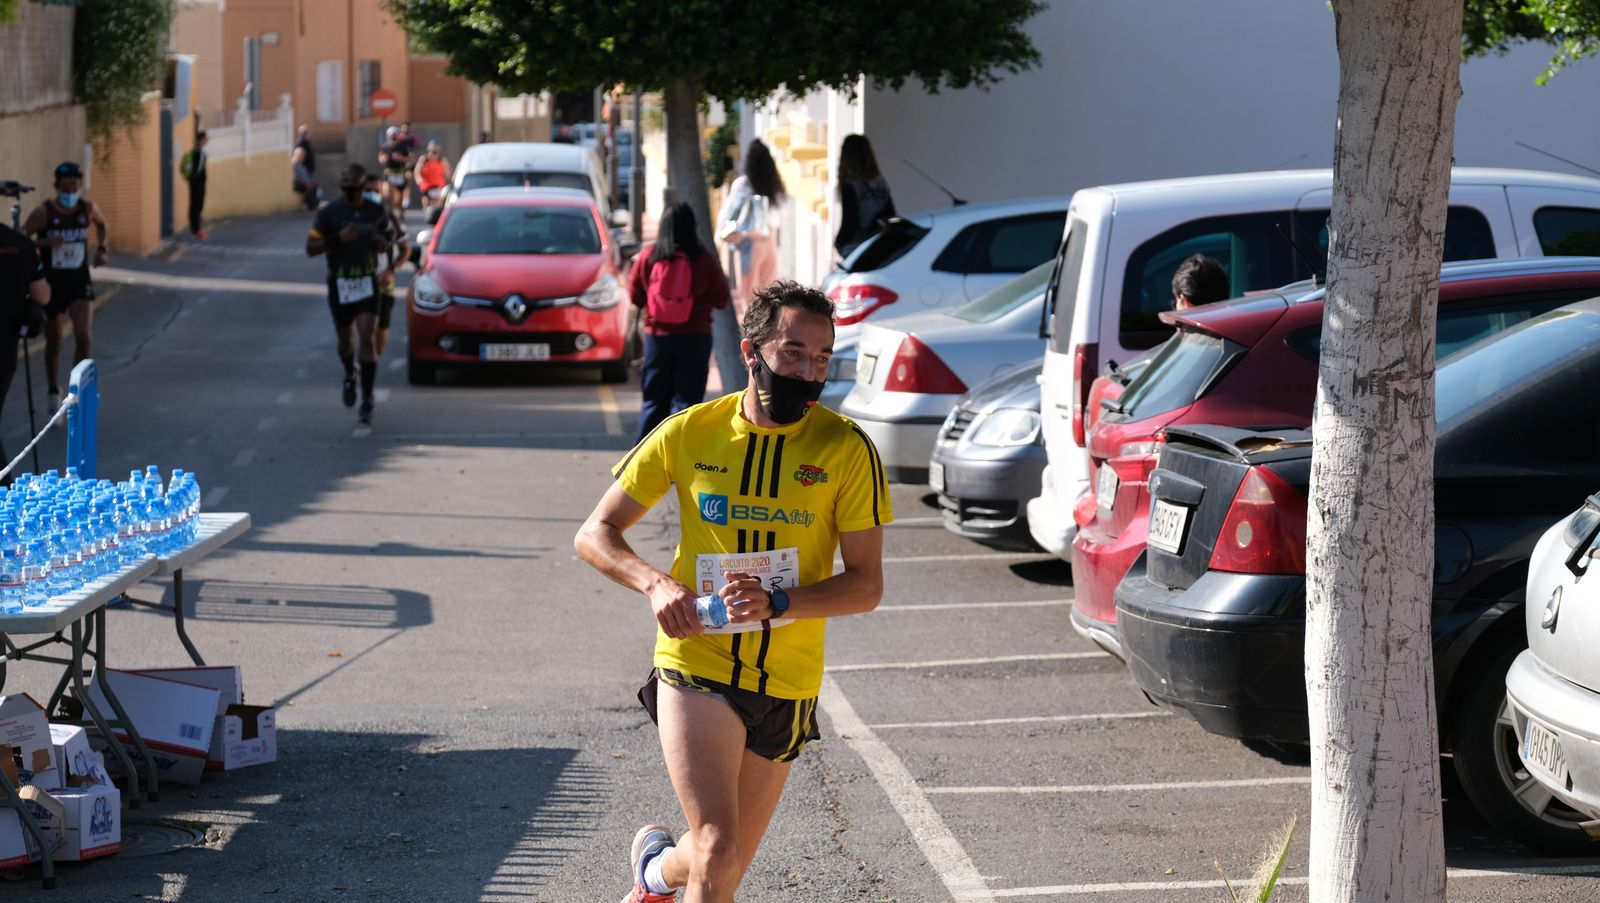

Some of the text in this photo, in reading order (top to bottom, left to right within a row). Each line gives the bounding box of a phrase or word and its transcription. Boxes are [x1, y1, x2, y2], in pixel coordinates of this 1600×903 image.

[694, 462, 719, 473] daen
[719, 558, 750, 569] CIRCUITO
[751, 555, 771, 568] 2020
[1529, 725, 1549, 767] 0145
